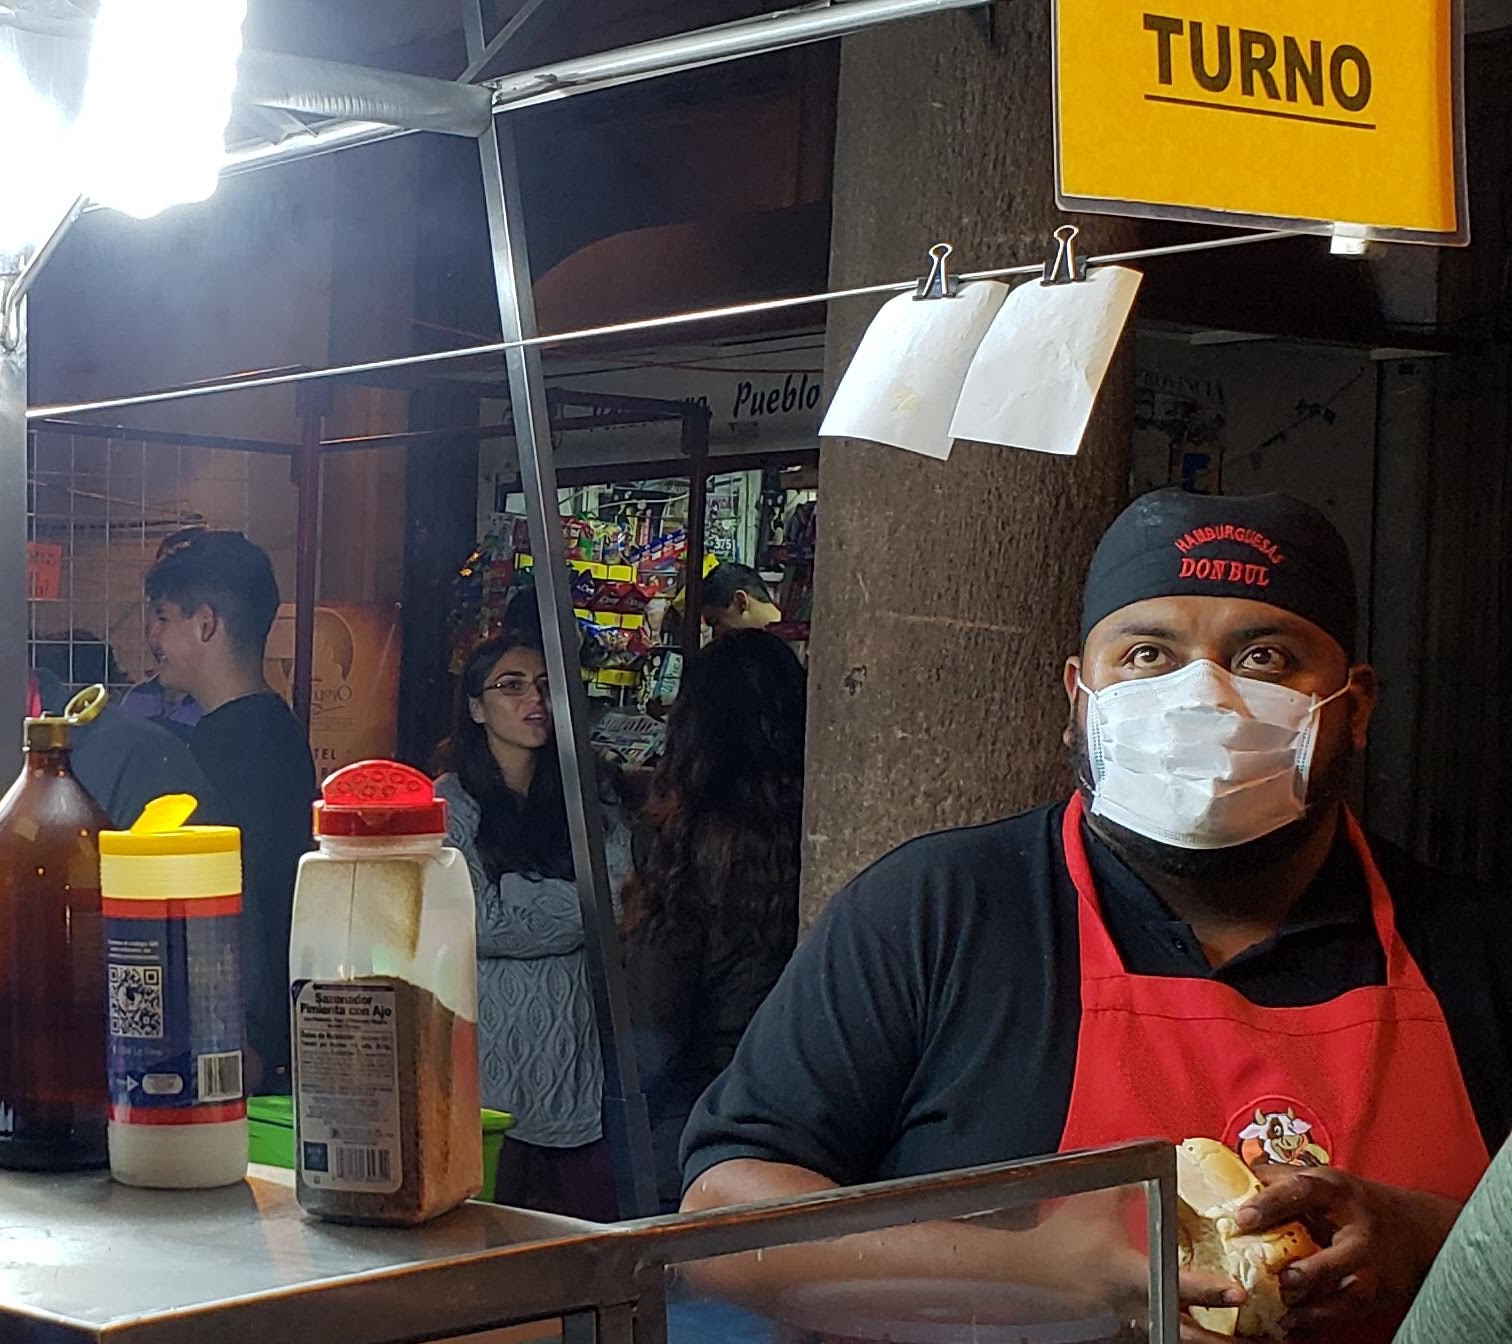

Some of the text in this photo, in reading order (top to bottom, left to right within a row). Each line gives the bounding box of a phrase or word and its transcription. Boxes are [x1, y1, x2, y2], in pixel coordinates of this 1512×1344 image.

[1143, 13, 1373, 111] TURNO
[734, 373, 821, 419] Pueblo
[1174, 524, 1285, 564] HAMBURGUESAS
[1179, 557, 1270, 587] DON BUL
[314, 748, 337, 760] TEL
[300, 1002, 392, 1019] Pimienta con Ajo
[315, 992, 372, 1006] Sazonador
